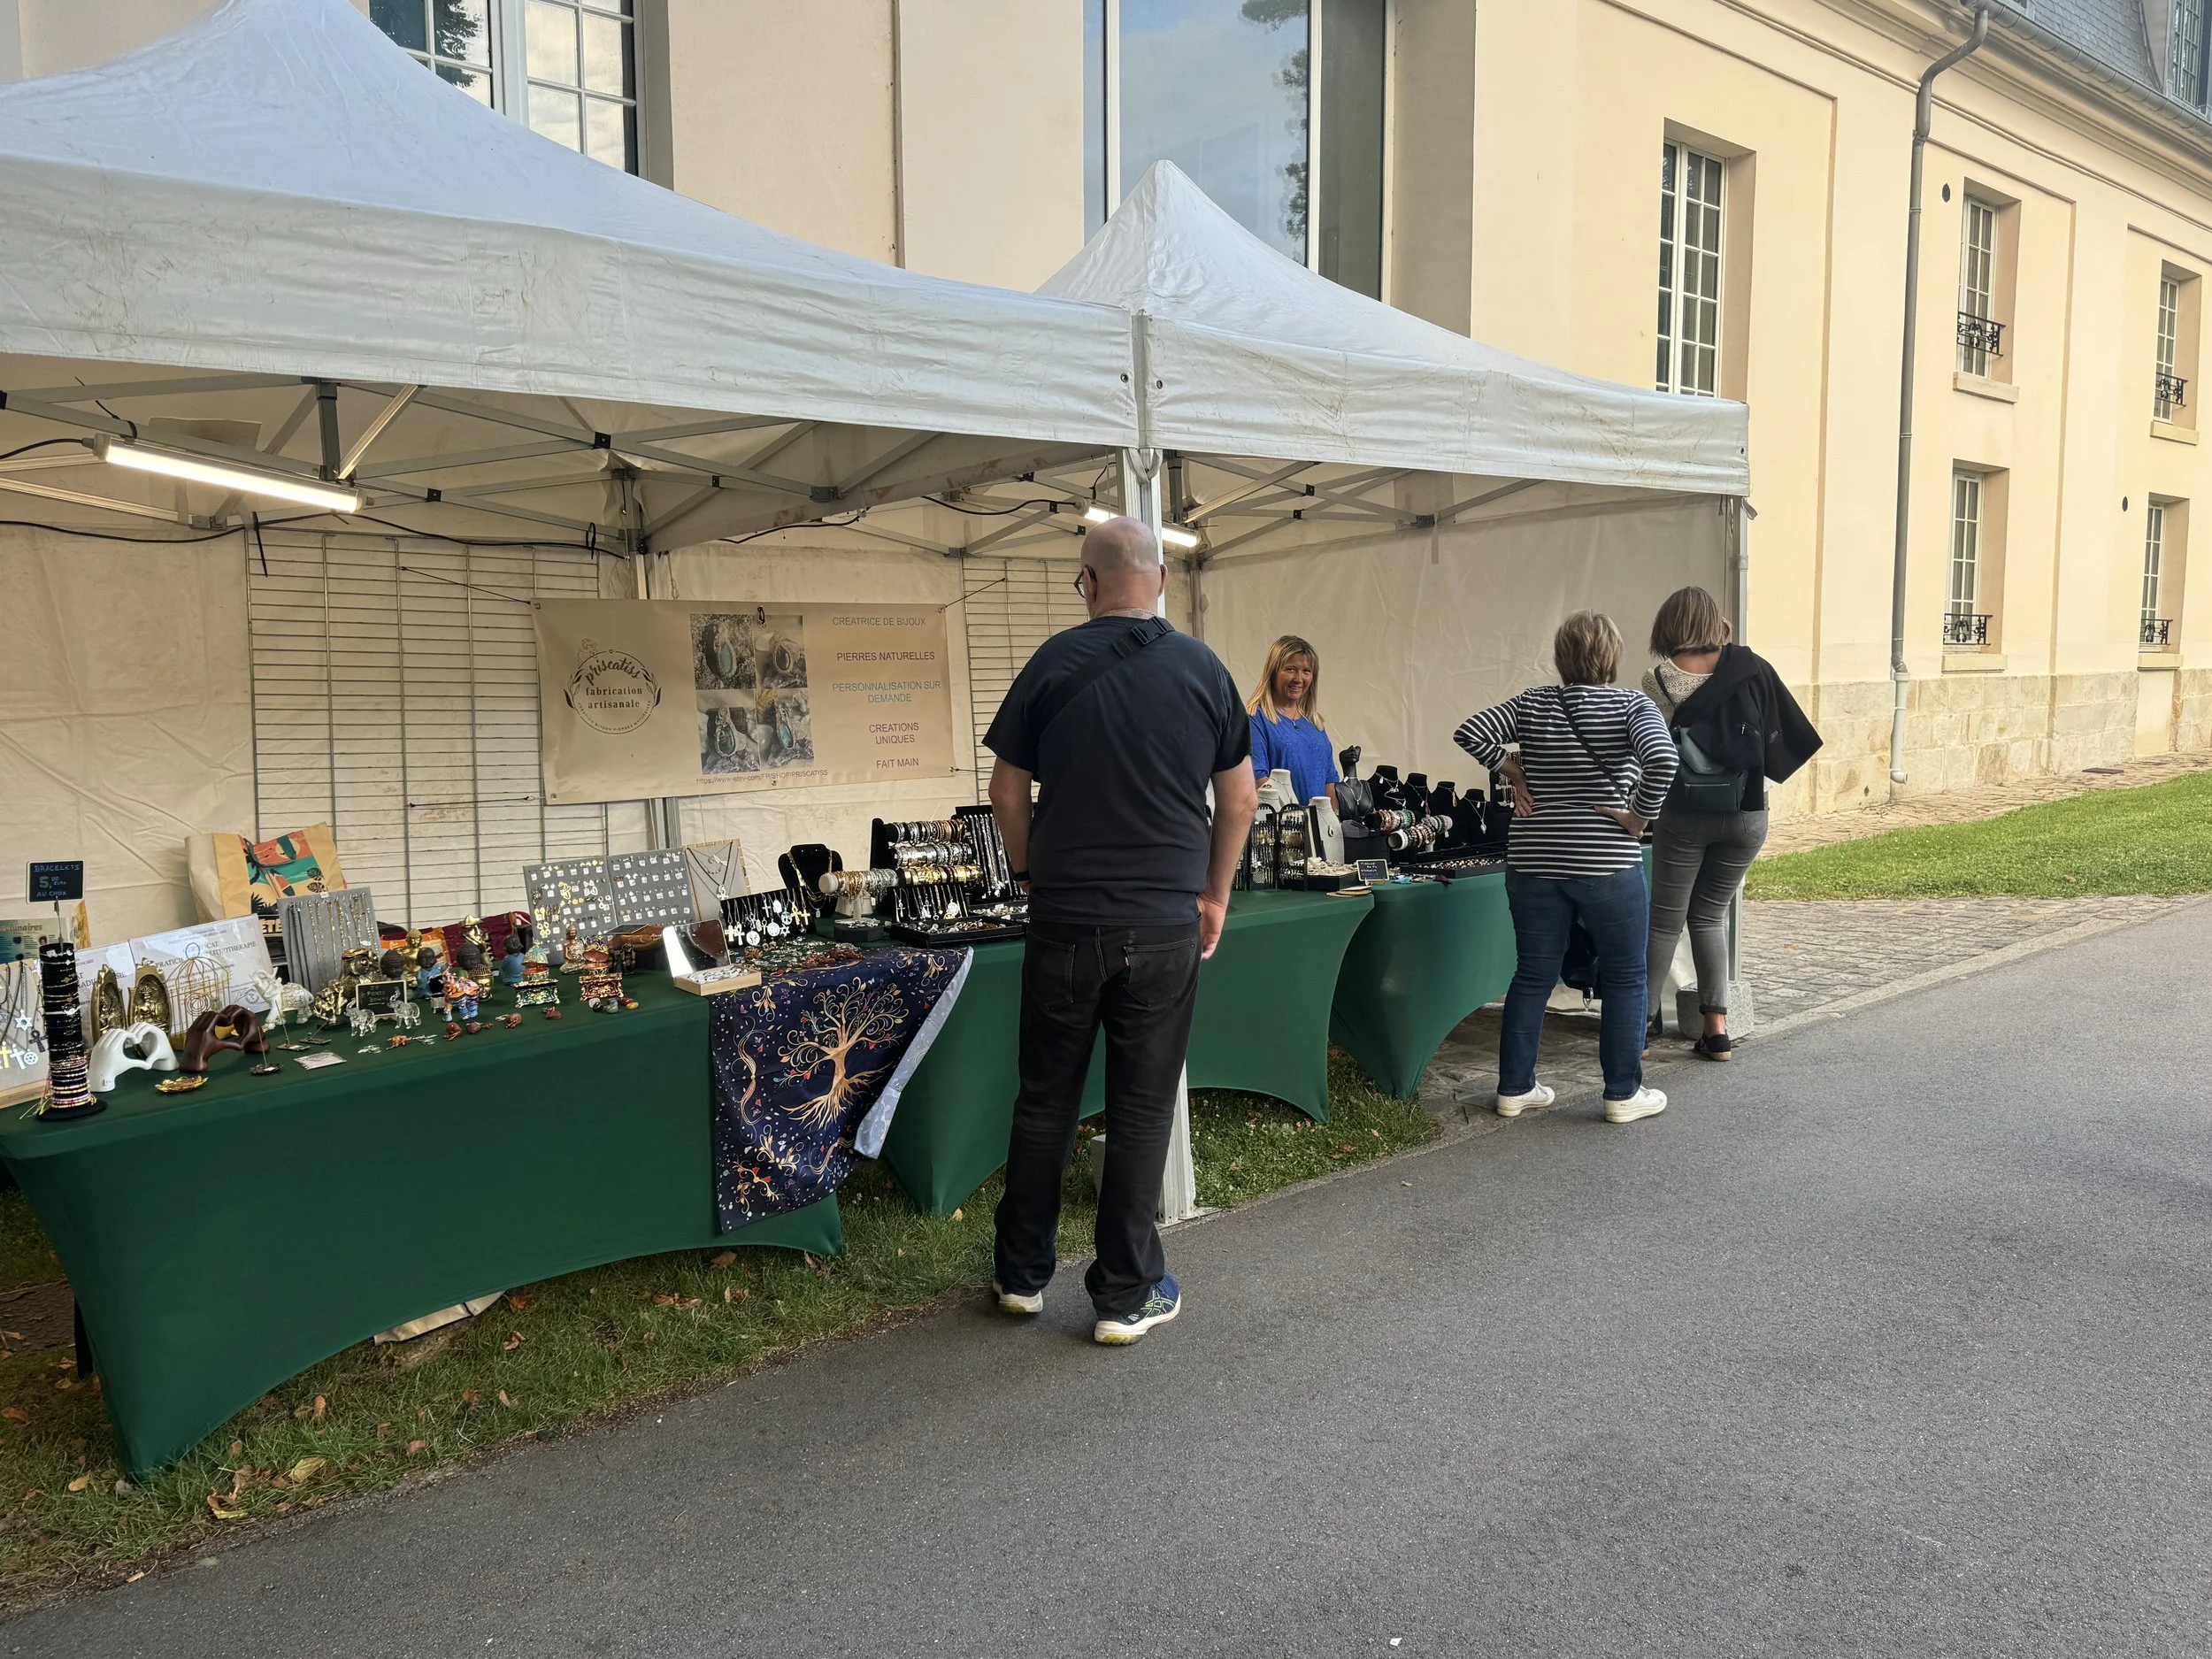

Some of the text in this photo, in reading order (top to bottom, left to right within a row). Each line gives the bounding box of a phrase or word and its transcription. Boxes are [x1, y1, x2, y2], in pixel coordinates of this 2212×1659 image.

[833, 617, 926, 626] CREATRICE DE BIJOUX
[836, 651, 935, 662] PIERRES NATURELLES
[584, 657, 641, 687] priscatiss
[586, 686, 643, 696] fabrication
[832, 680, 941, 692] PERSONNALISATION SUR
[867, 693, 912, 703] DEMANDE
[588, 699, 641, 709] artisanale
[869, 722, 919, 733] CREATIONS
[875, 734, 916, 745] UNIQUES
[876, 757, 919, 769] FAIT MAIN
[34, 864, 80, 872] BRACELETS
